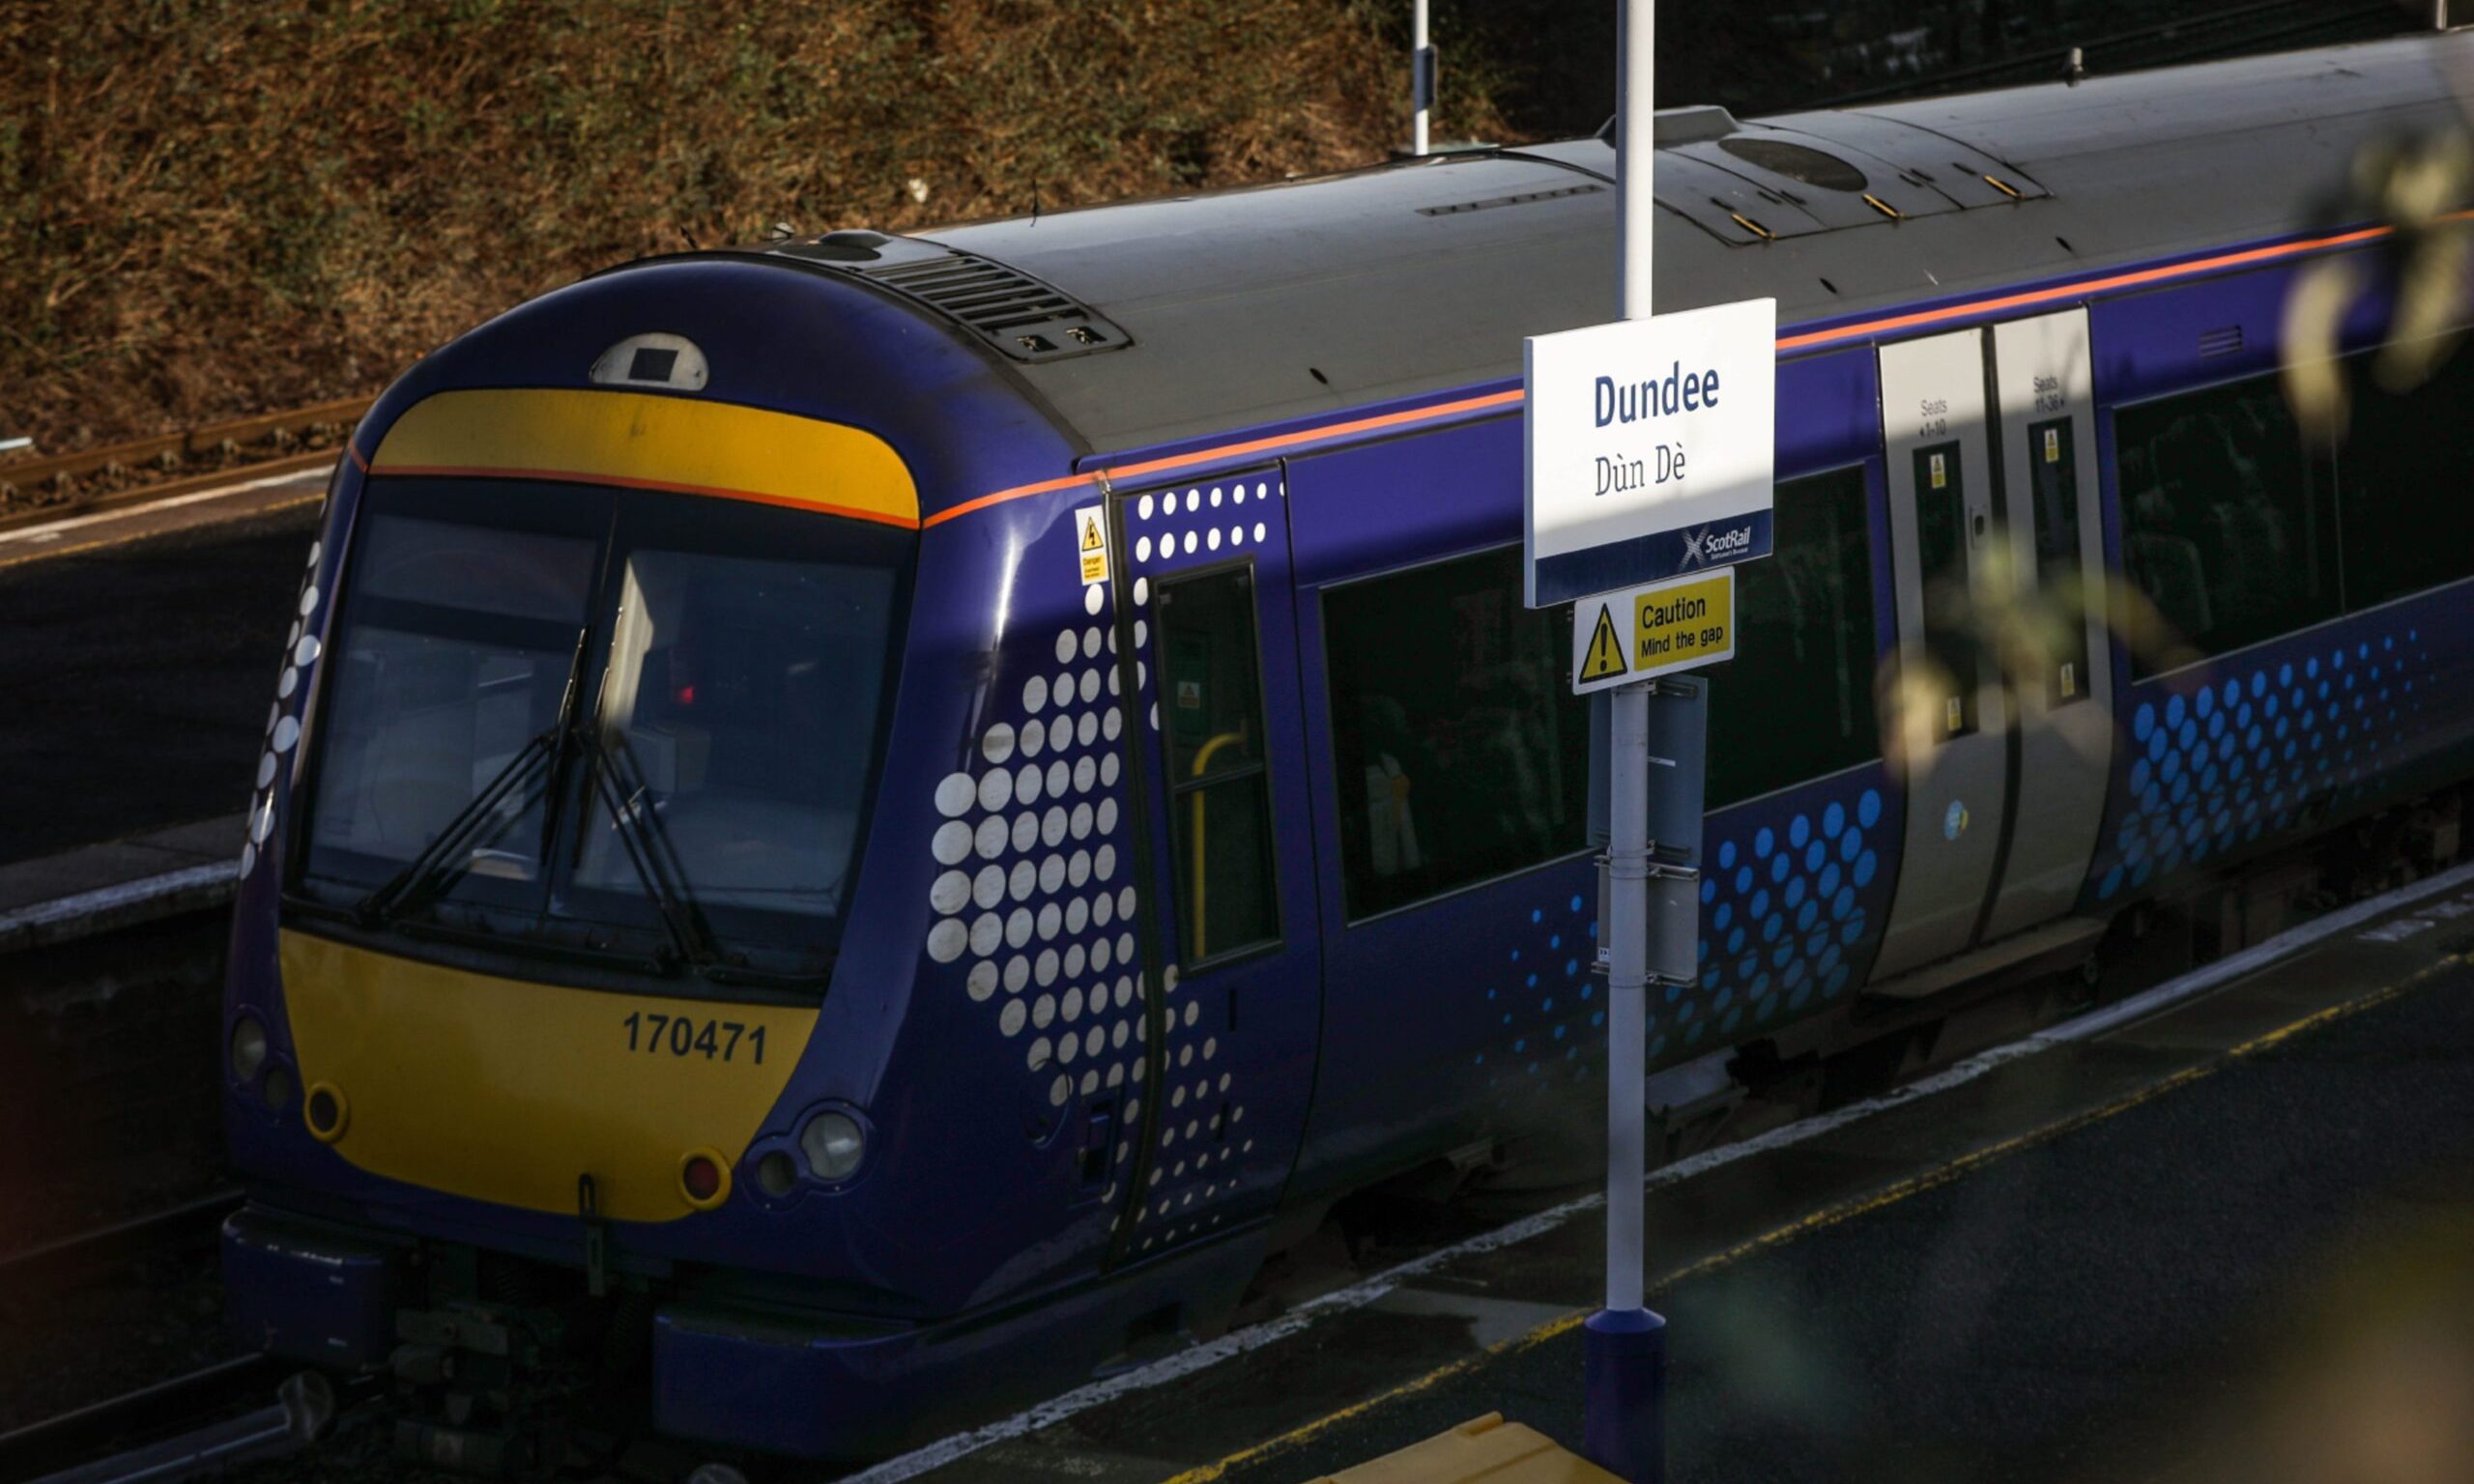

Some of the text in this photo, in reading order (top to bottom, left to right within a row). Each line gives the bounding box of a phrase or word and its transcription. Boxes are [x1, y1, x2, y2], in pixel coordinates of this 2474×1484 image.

[1595, 360, 1719, 428] Dundee
[2033, 376, 2058, 393] Seats
[1921, 399, 1948, 416] Seats
[1595, 442, 1685, 496] Dùn Dè
[1706, 526, 1751, 554] ScotRail
[1643, 597, 1706, 629] Caution
[1642, 626, 1724, 658] Mind the gap
[623, 1011, 765, 1065] 170471
